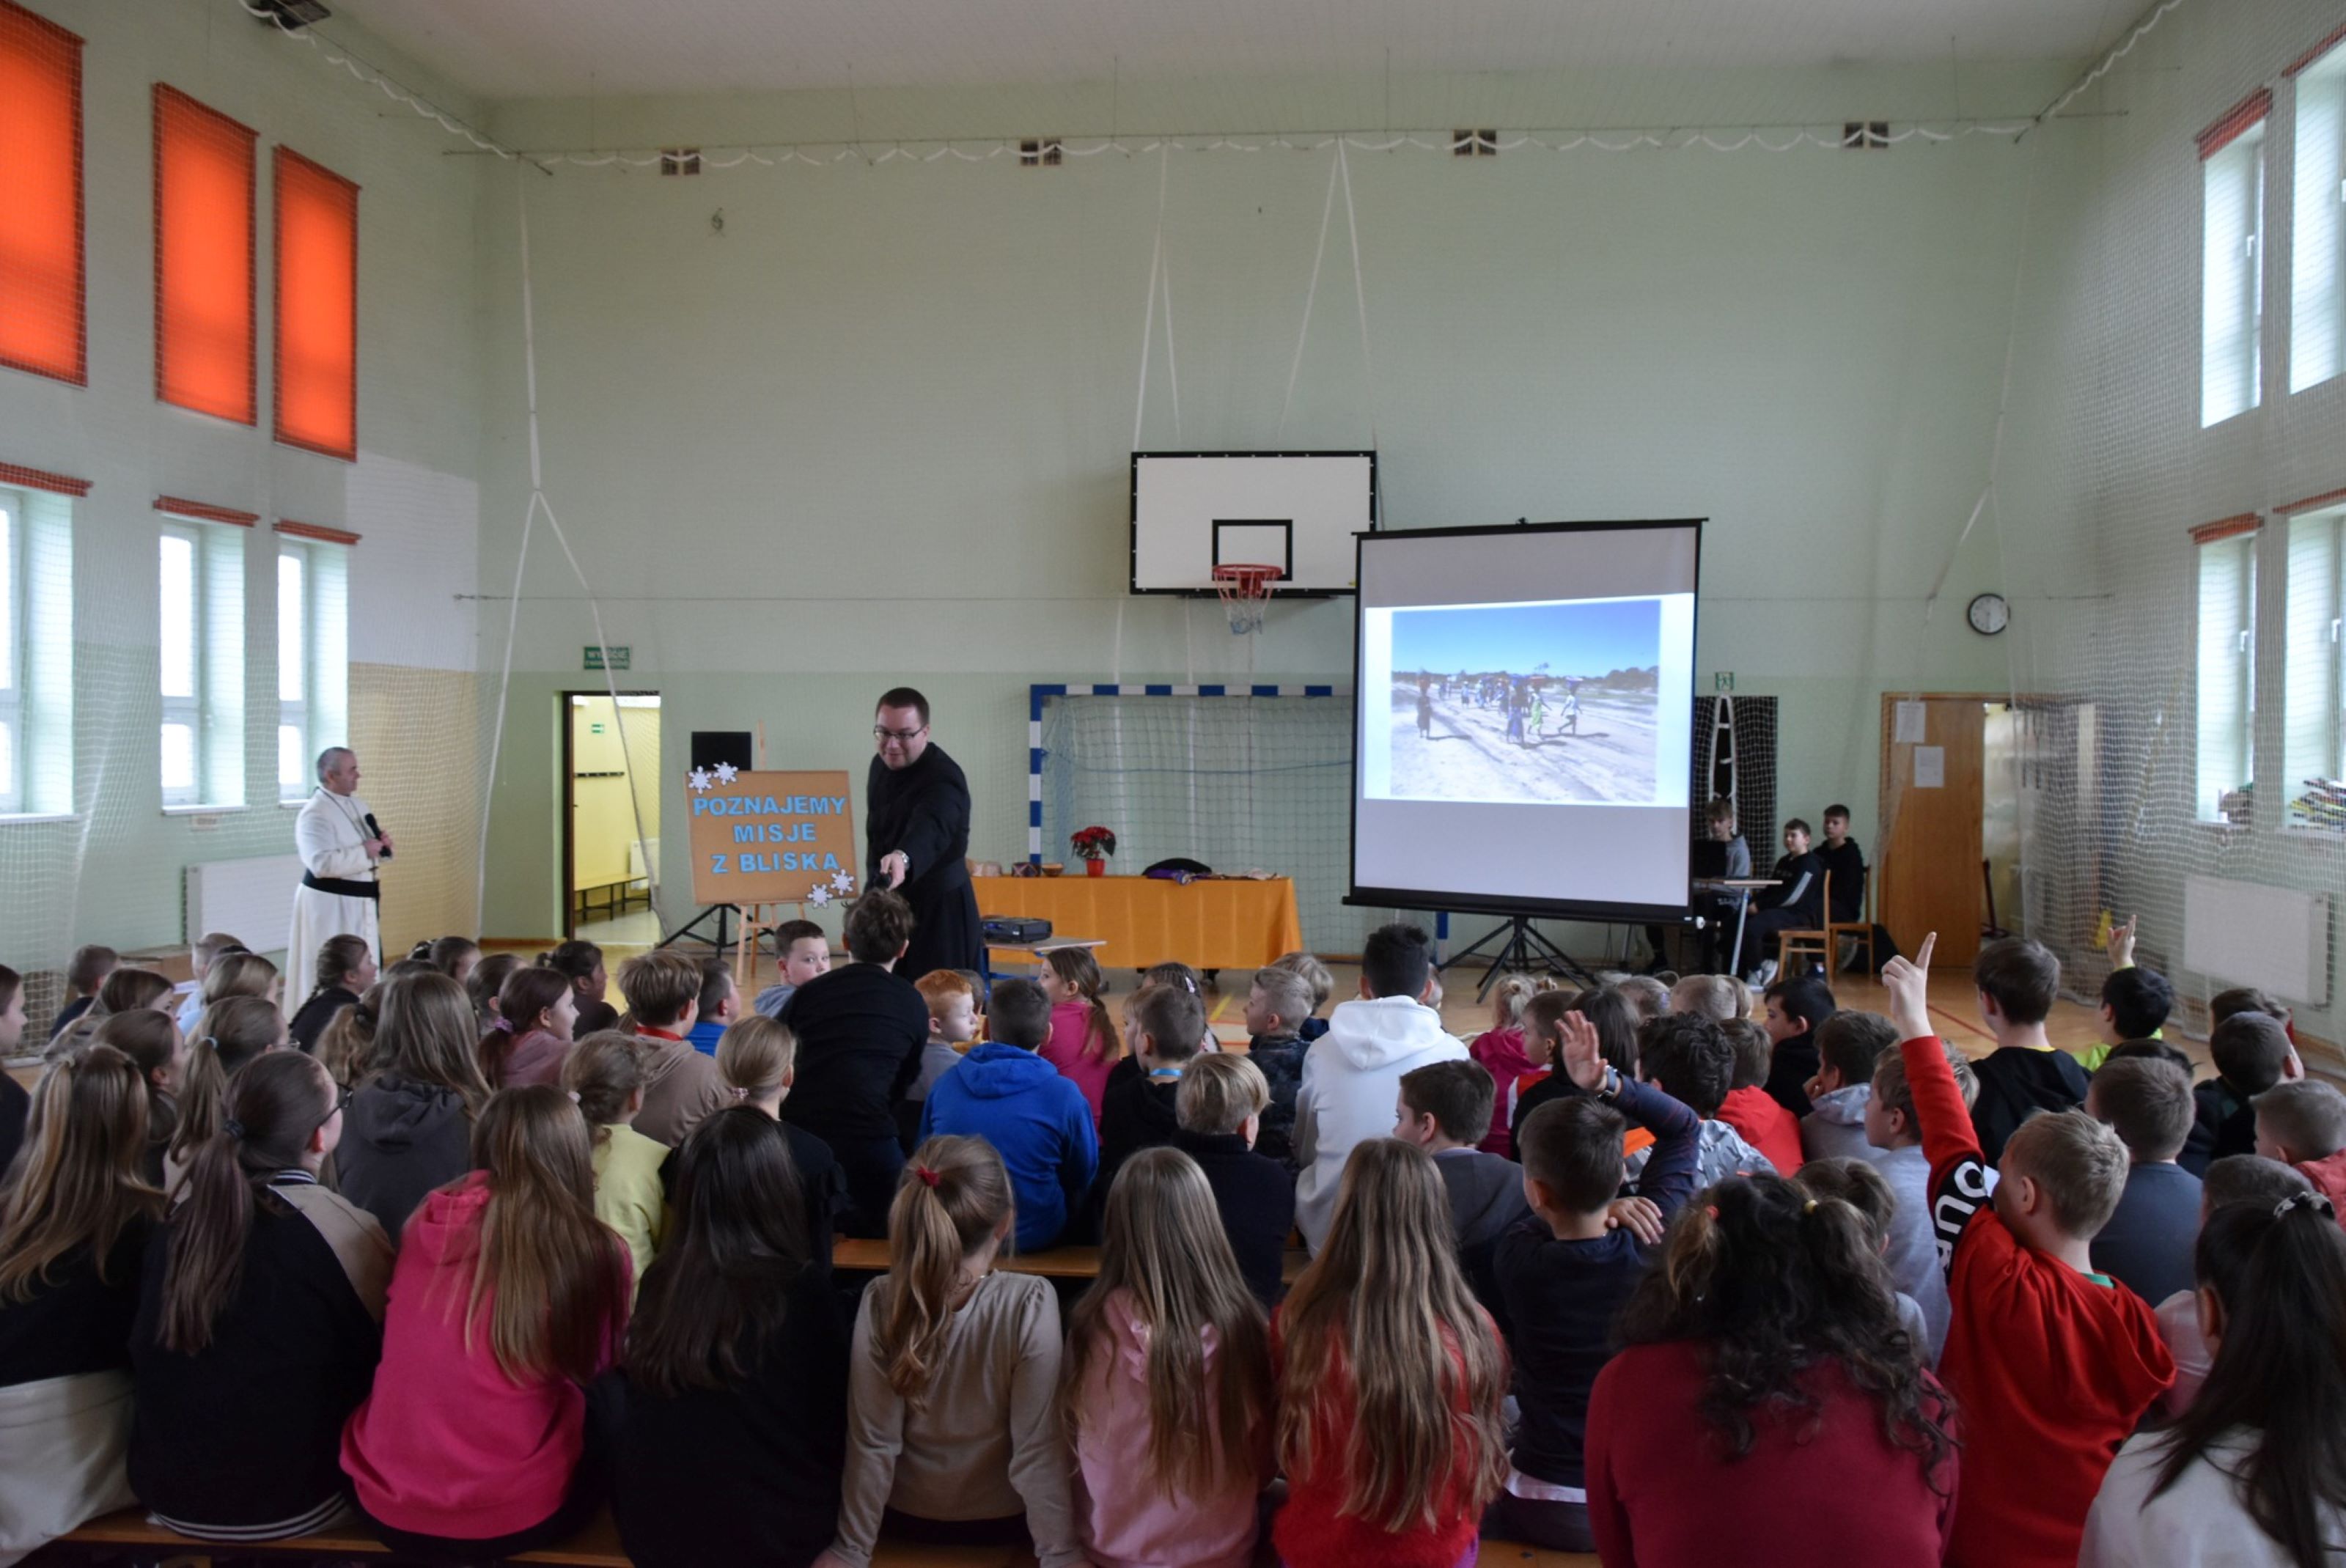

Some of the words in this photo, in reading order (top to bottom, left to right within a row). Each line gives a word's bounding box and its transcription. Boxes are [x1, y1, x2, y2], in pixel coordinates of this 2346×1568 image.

[693, 797, 845, 816] POZNAJEMY
[734, 823, 816, 843] MISJE
[711, 854, 728, 874] Z
[739, 852, 839, 872] BLISKA
